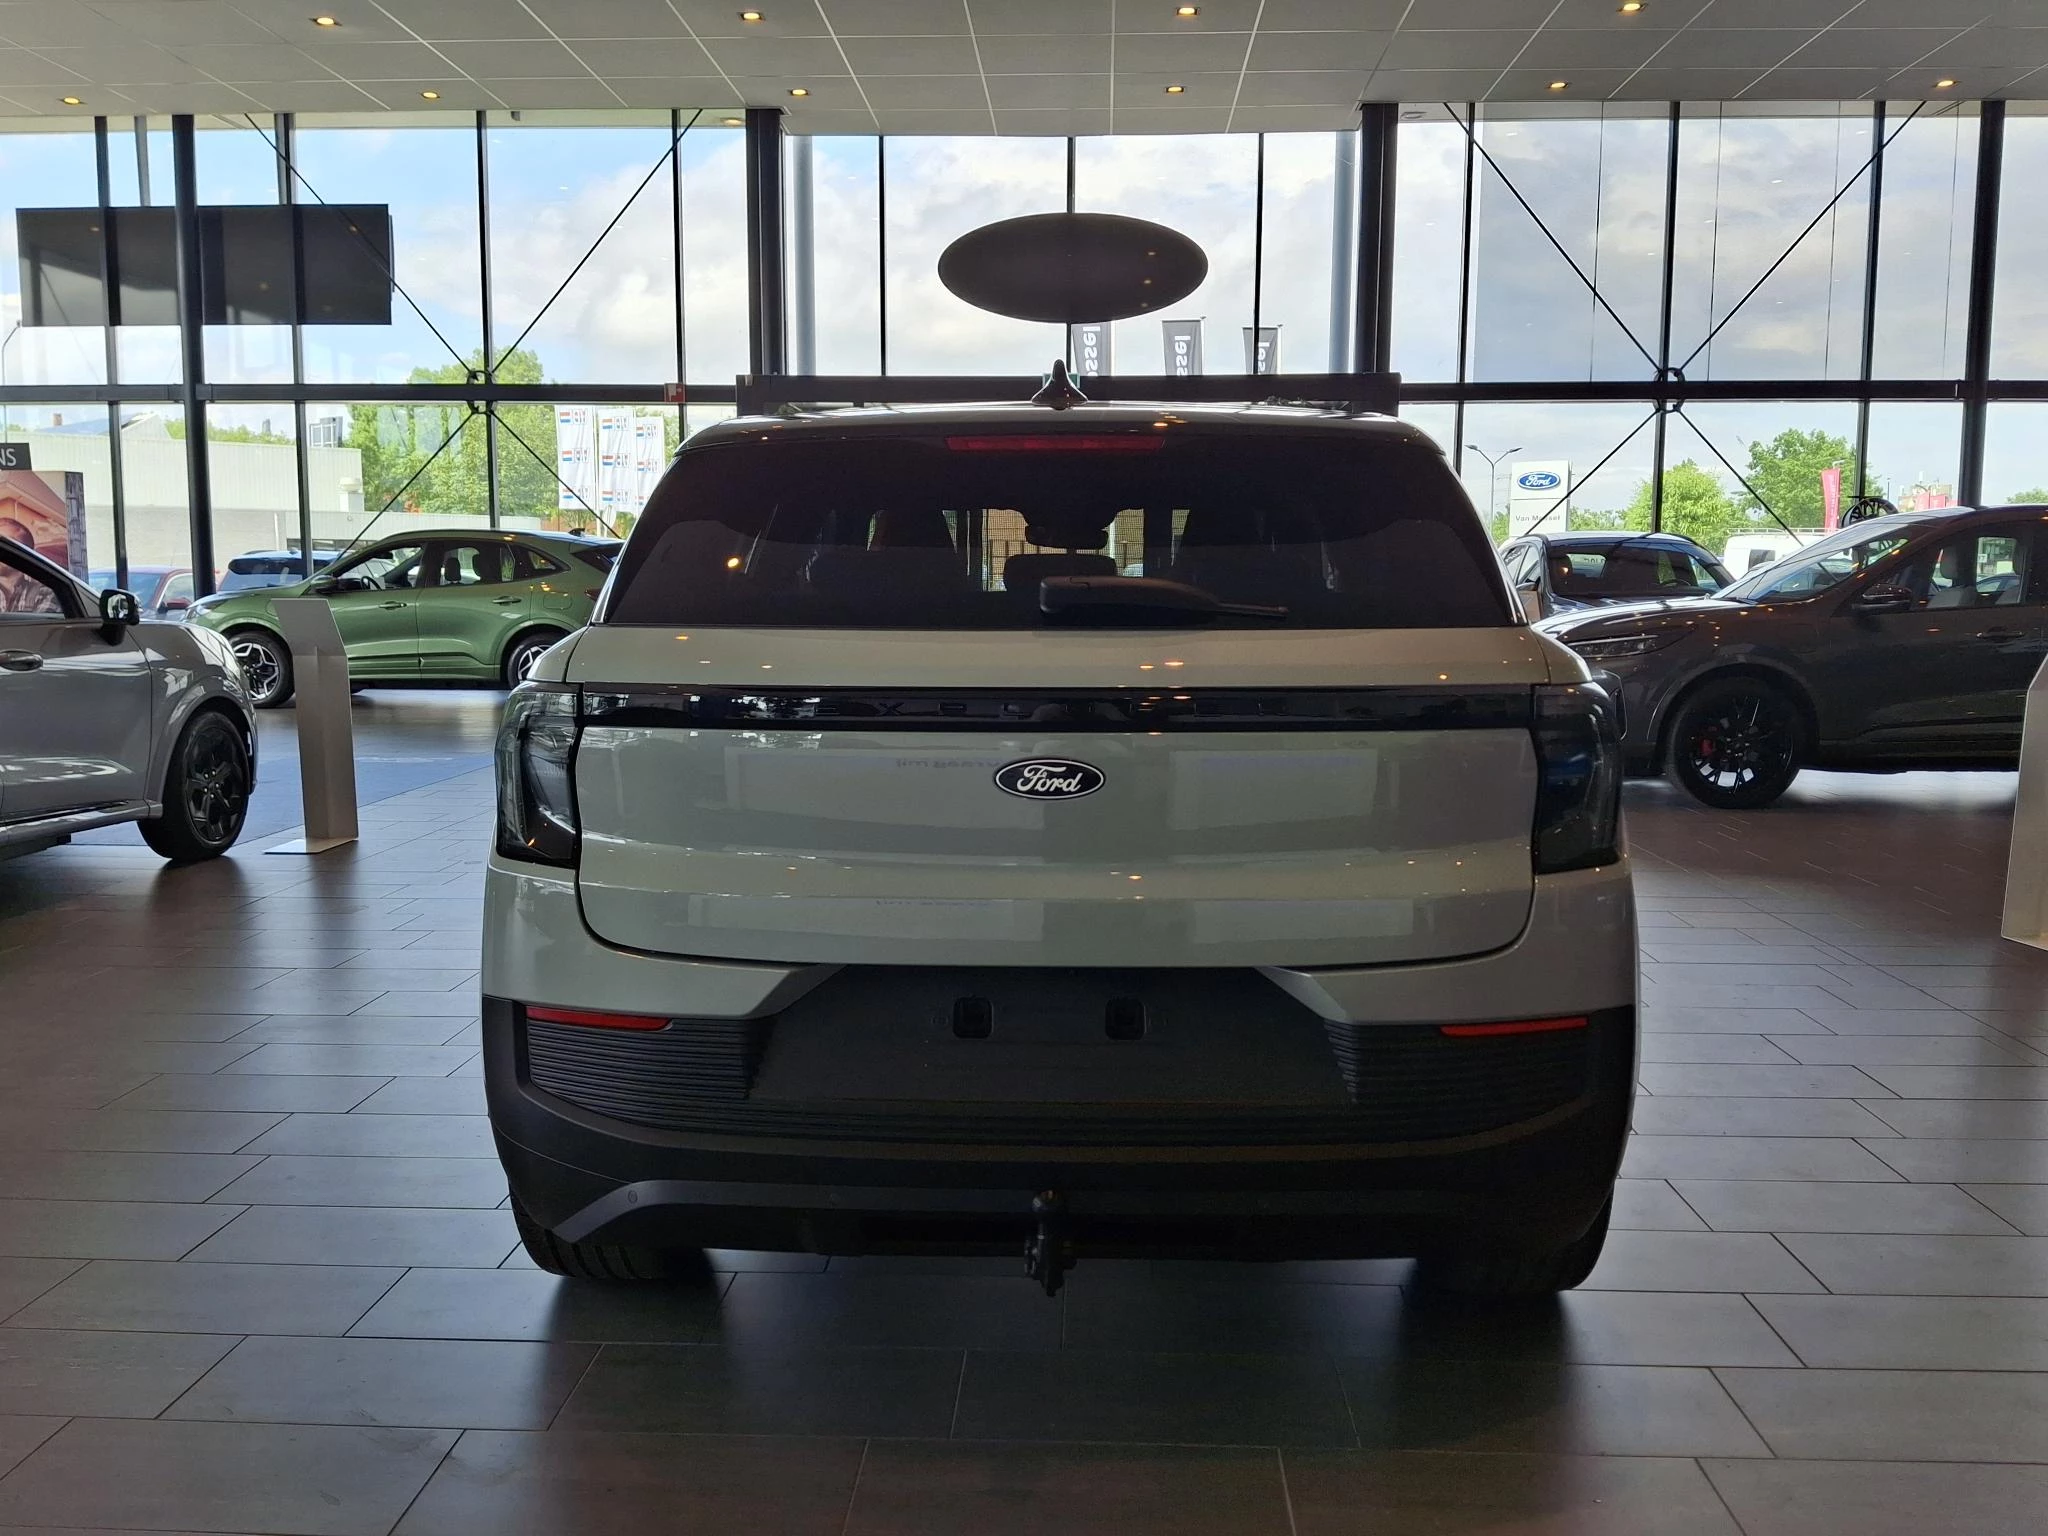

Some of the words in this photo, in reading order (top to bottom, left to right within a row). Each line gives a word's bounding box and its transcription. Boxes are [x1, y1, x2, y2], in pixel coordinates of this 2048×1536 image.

[1515, 514, 1530, 522] Van
[1532, 513, 1561, 522] Msel
[1016, 765, 1084, 792] Ford
